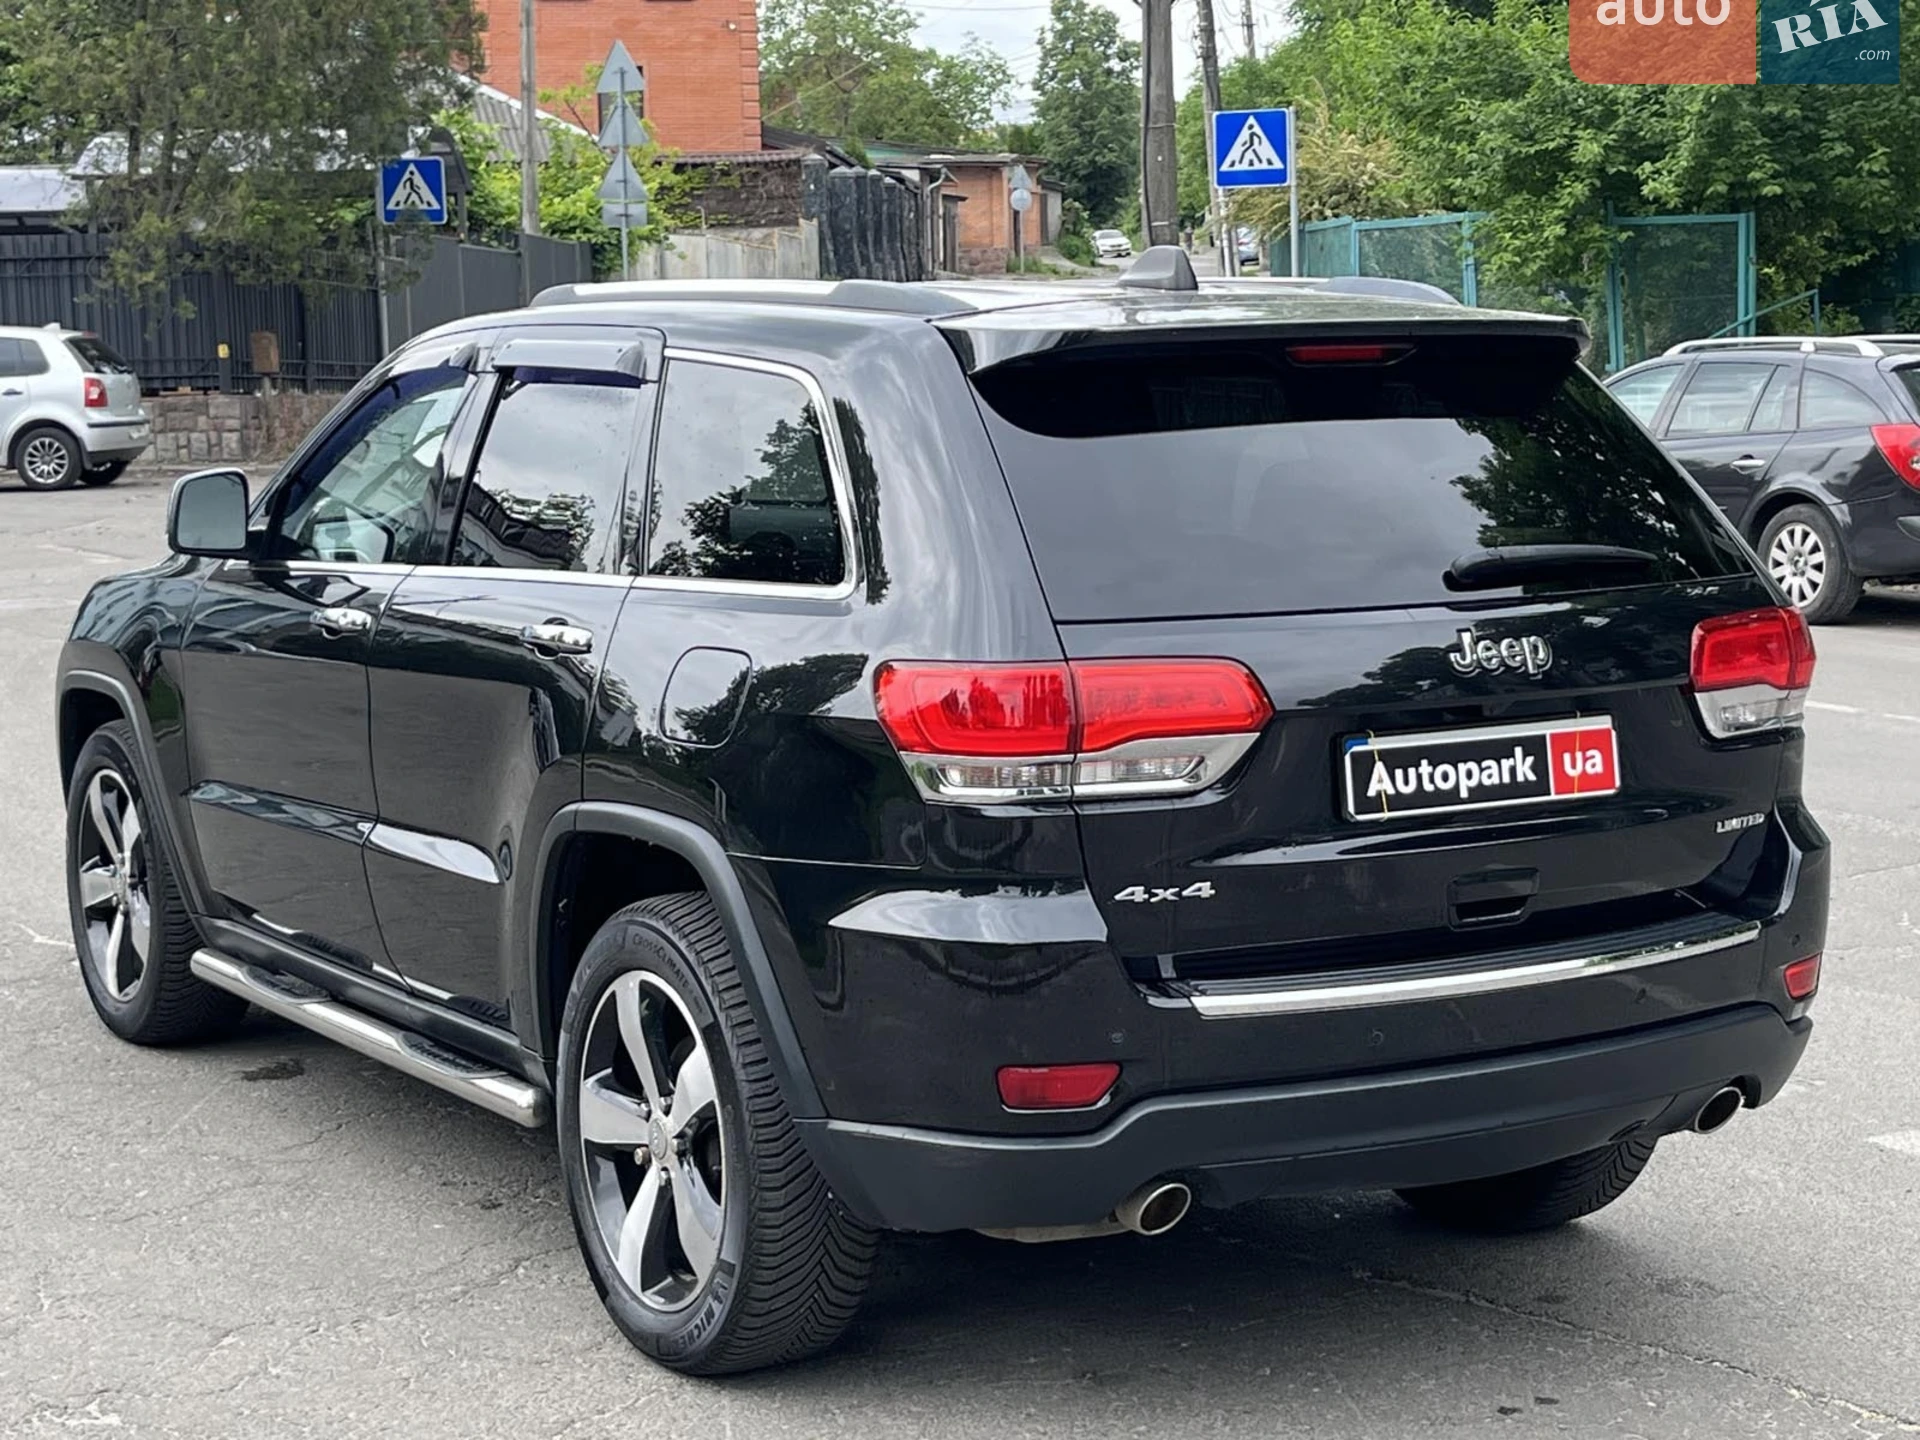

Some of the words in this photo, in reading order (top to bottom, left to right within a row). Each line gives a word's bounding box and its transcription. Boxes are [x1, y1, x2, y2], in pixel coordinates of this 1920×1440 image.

[1449, 630, 1550, 675] Jeep
[1366, 746, 1538, 799] Autopark
[1562, 748, 1604, 778] ua
[1113, 881, 1216, 902] 4x4
